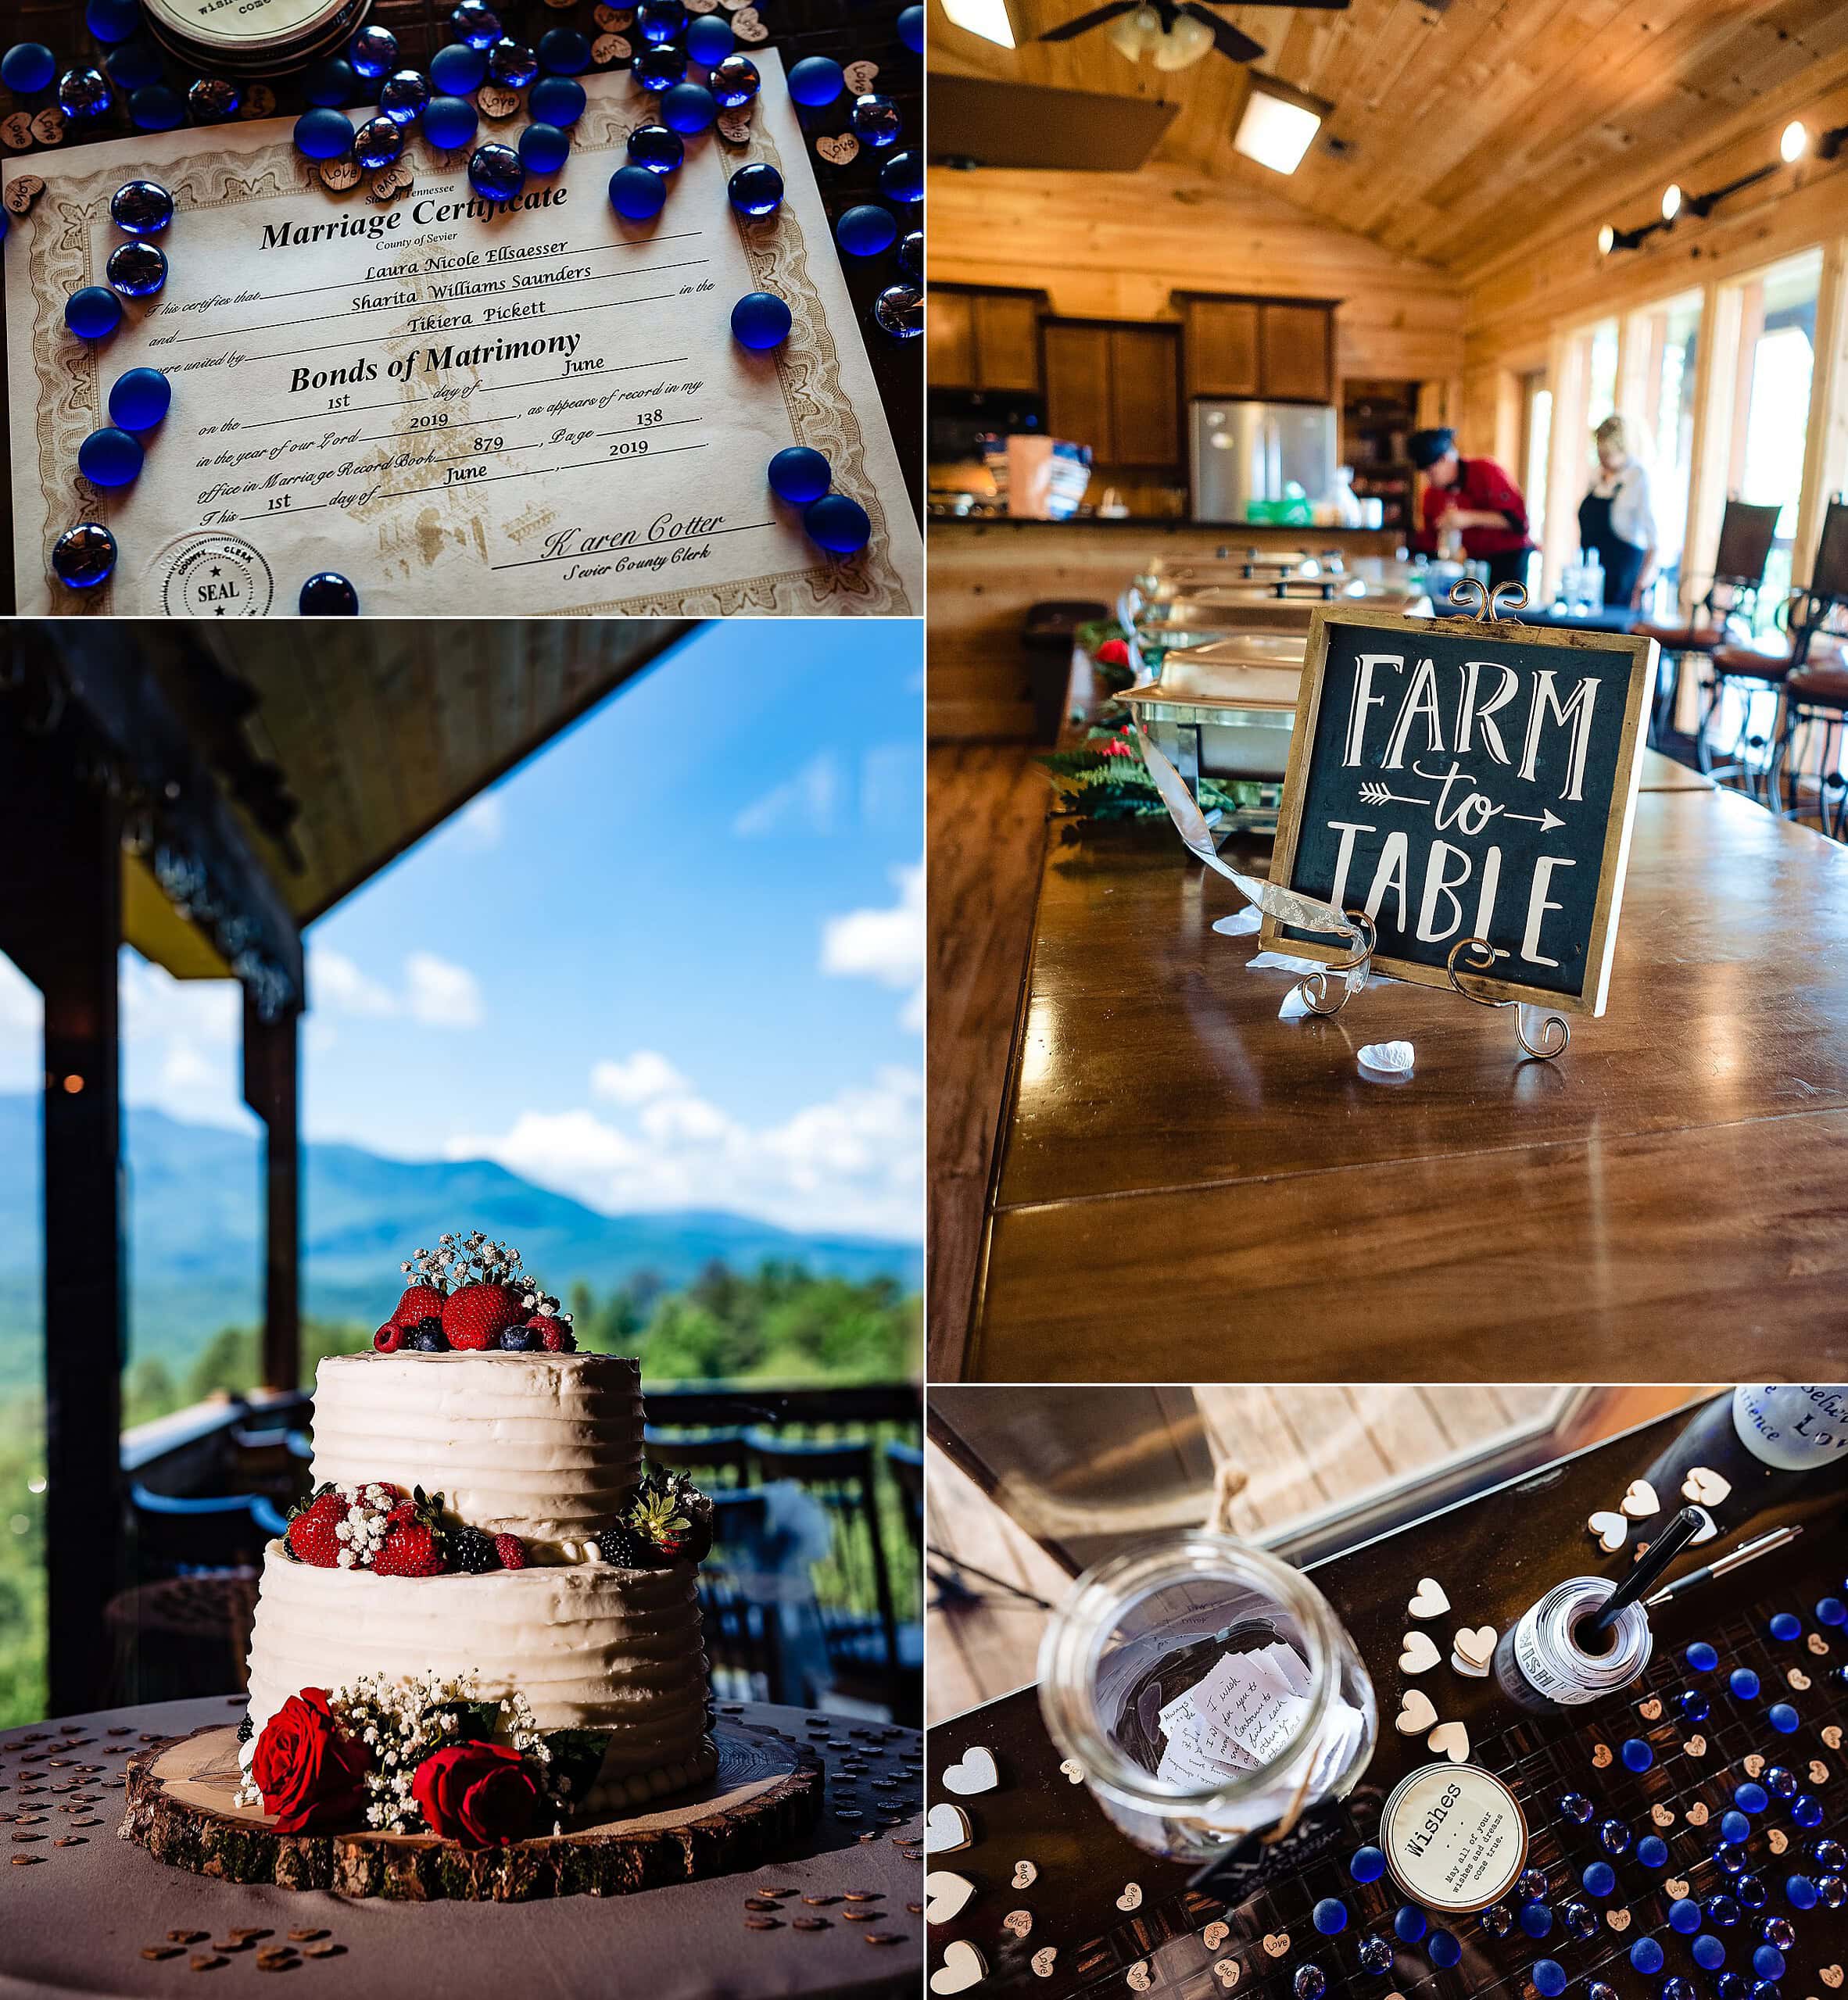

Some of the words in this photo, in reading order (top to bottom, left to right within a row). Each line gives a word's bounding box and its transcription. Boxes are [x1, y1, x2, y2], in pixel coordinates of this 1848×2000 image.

[853, 65, 867, 91] Love
[483, 96, 514, 108] Love
[7, 121, 26, 146] Love
[41, 113, 56, 141] Love
[822, 140, 854, 159] Love
[324, 166, 357, 181] Love
[377, 169, 405, 192] Love
[13, 178, 33, 208] Love
[406, 185, 455, 199] Tennessee
[259, 213, 402, 251] Marriage
[412, 186, 568, 225] Certificate
[375, 239, 412, 252] County
[414, 234, 428, 248] of
[427, 231, 458, 245] Sevier
[144, 302, 181, 318] This
[181, 294, 233, 313] certifies
[233, 290, 262, 304] that
[364, 261, 420, 281] Laura
[424, 249, 481, 272] Nicole
[485, 240, 569, 263] Ellsaesser
[149, 329, 180, 347] and
[352, 289, 417, 312] Sharita
[427, 274, 507, 299] Williams
[512, 264, 592, 288] Saunders
[156, 364, 182, 375] ere
[184, 352, 229, 372] united
[227, 350, 248, 369] by
[407, 311, 474, 334] Tikiera
[482, 300, 546, 322] Pickett
[679, 283, 694, 295] in
[696, 278, 715, 293] the
[288, 359, 378, 394] Bonds
[388, 349, 421, 383] of
[424, 331, 582, 374] Matrimony
[198, 425, 218, 436] on
[220, 417, 242, 432] the
[327, 393, 351, 410] 1st
[432, 385, 463, 401] day
[462, 379, 483, 400] of
[562, 356, 605, 377] June
[196, 456, 213, 468] in
[214, 449, 235, 465] the
[231, 446, 269, 467] year
[269, 439, 292, 461] of
[289, 439, 316, 453] our
[317, 427, 363, 450] Lord
[410, 413, 449, 430] 2019
[526, 403, 546, 417] as
[546, 395, 599, 419] appears
[598, 389, 618, 409] of
[618, 380, 664, 403] record
[664, 382, 680, 395] in
[680, 380, 704, 395] my
[197, 481, 242, 505] office
[242, 480, 259, 492] in
[259, 469, 337, 491] Marriage
[336, 455, 394, 478] Record
[393, 449, 438, 469] Book
[473, 435, 504, 453] 879
[548, 425, 596, 446] Page
[636, 408, 664, 427] 138
[199, 508, 239, 528] This
[268, 493, 292, 511] 1st
[328, 491, 359, 506] day
[357, 485, 381, 506] of
[443, 464, 488, 486] June
[609, 439, 650, 457] 2019
[540, 526, 644, 560] Karen
[647, 511, 726, 542] Cotter
[178, 548, 207, 576] COUNTY
[224, 546, 255, 564] CLERK
[563, 563, 613, 581] Sevier
[614, 554, 668, 575] County
[670, 542, 712, 566] Clerk
[198, 581, 241, 603] SEAL
[1341, 654, 1603, 802] FARM
[1413, 759, 1506, 836] to
[1327, 821, 1578, 968] TABLE
[1405, 1783, 1462, 1858] Wishes
[1655, 1809, 1672, 1822] Love
[1445, 1865, 1460, 1884] May
[1459, 1847, 1471, 1864] all
[1469, 1833, 1479, 1845] of
[1476, 1811, 1492, 1834] your
[1452, 1862, 1474, 1894] wishes
[1472, 1844, 1484, 1862] and
[1483, 1813, 1504, 1844] dreams
[1474, 1860, 1489, 1882] come
[1486, 1836, 1504, 1859] true.
[1020, 1863, 1030, 1886] Love
[1124, 1887, 1137, 1909] Love
[1669, 1884, 1687, 1894] Love
[1008, 1916, 1031, 1930] Love
[1609, 1915, 1628, 1927] Love
[1208, 1925, 1223, 1946] Love
[1266, 1939, 1288, 1952] Love
[1038, 1950, 1048, 1975] Love
[1219, 1963, 1237, 1982] Love
[1131, 1966, 1146, 1988] Love
